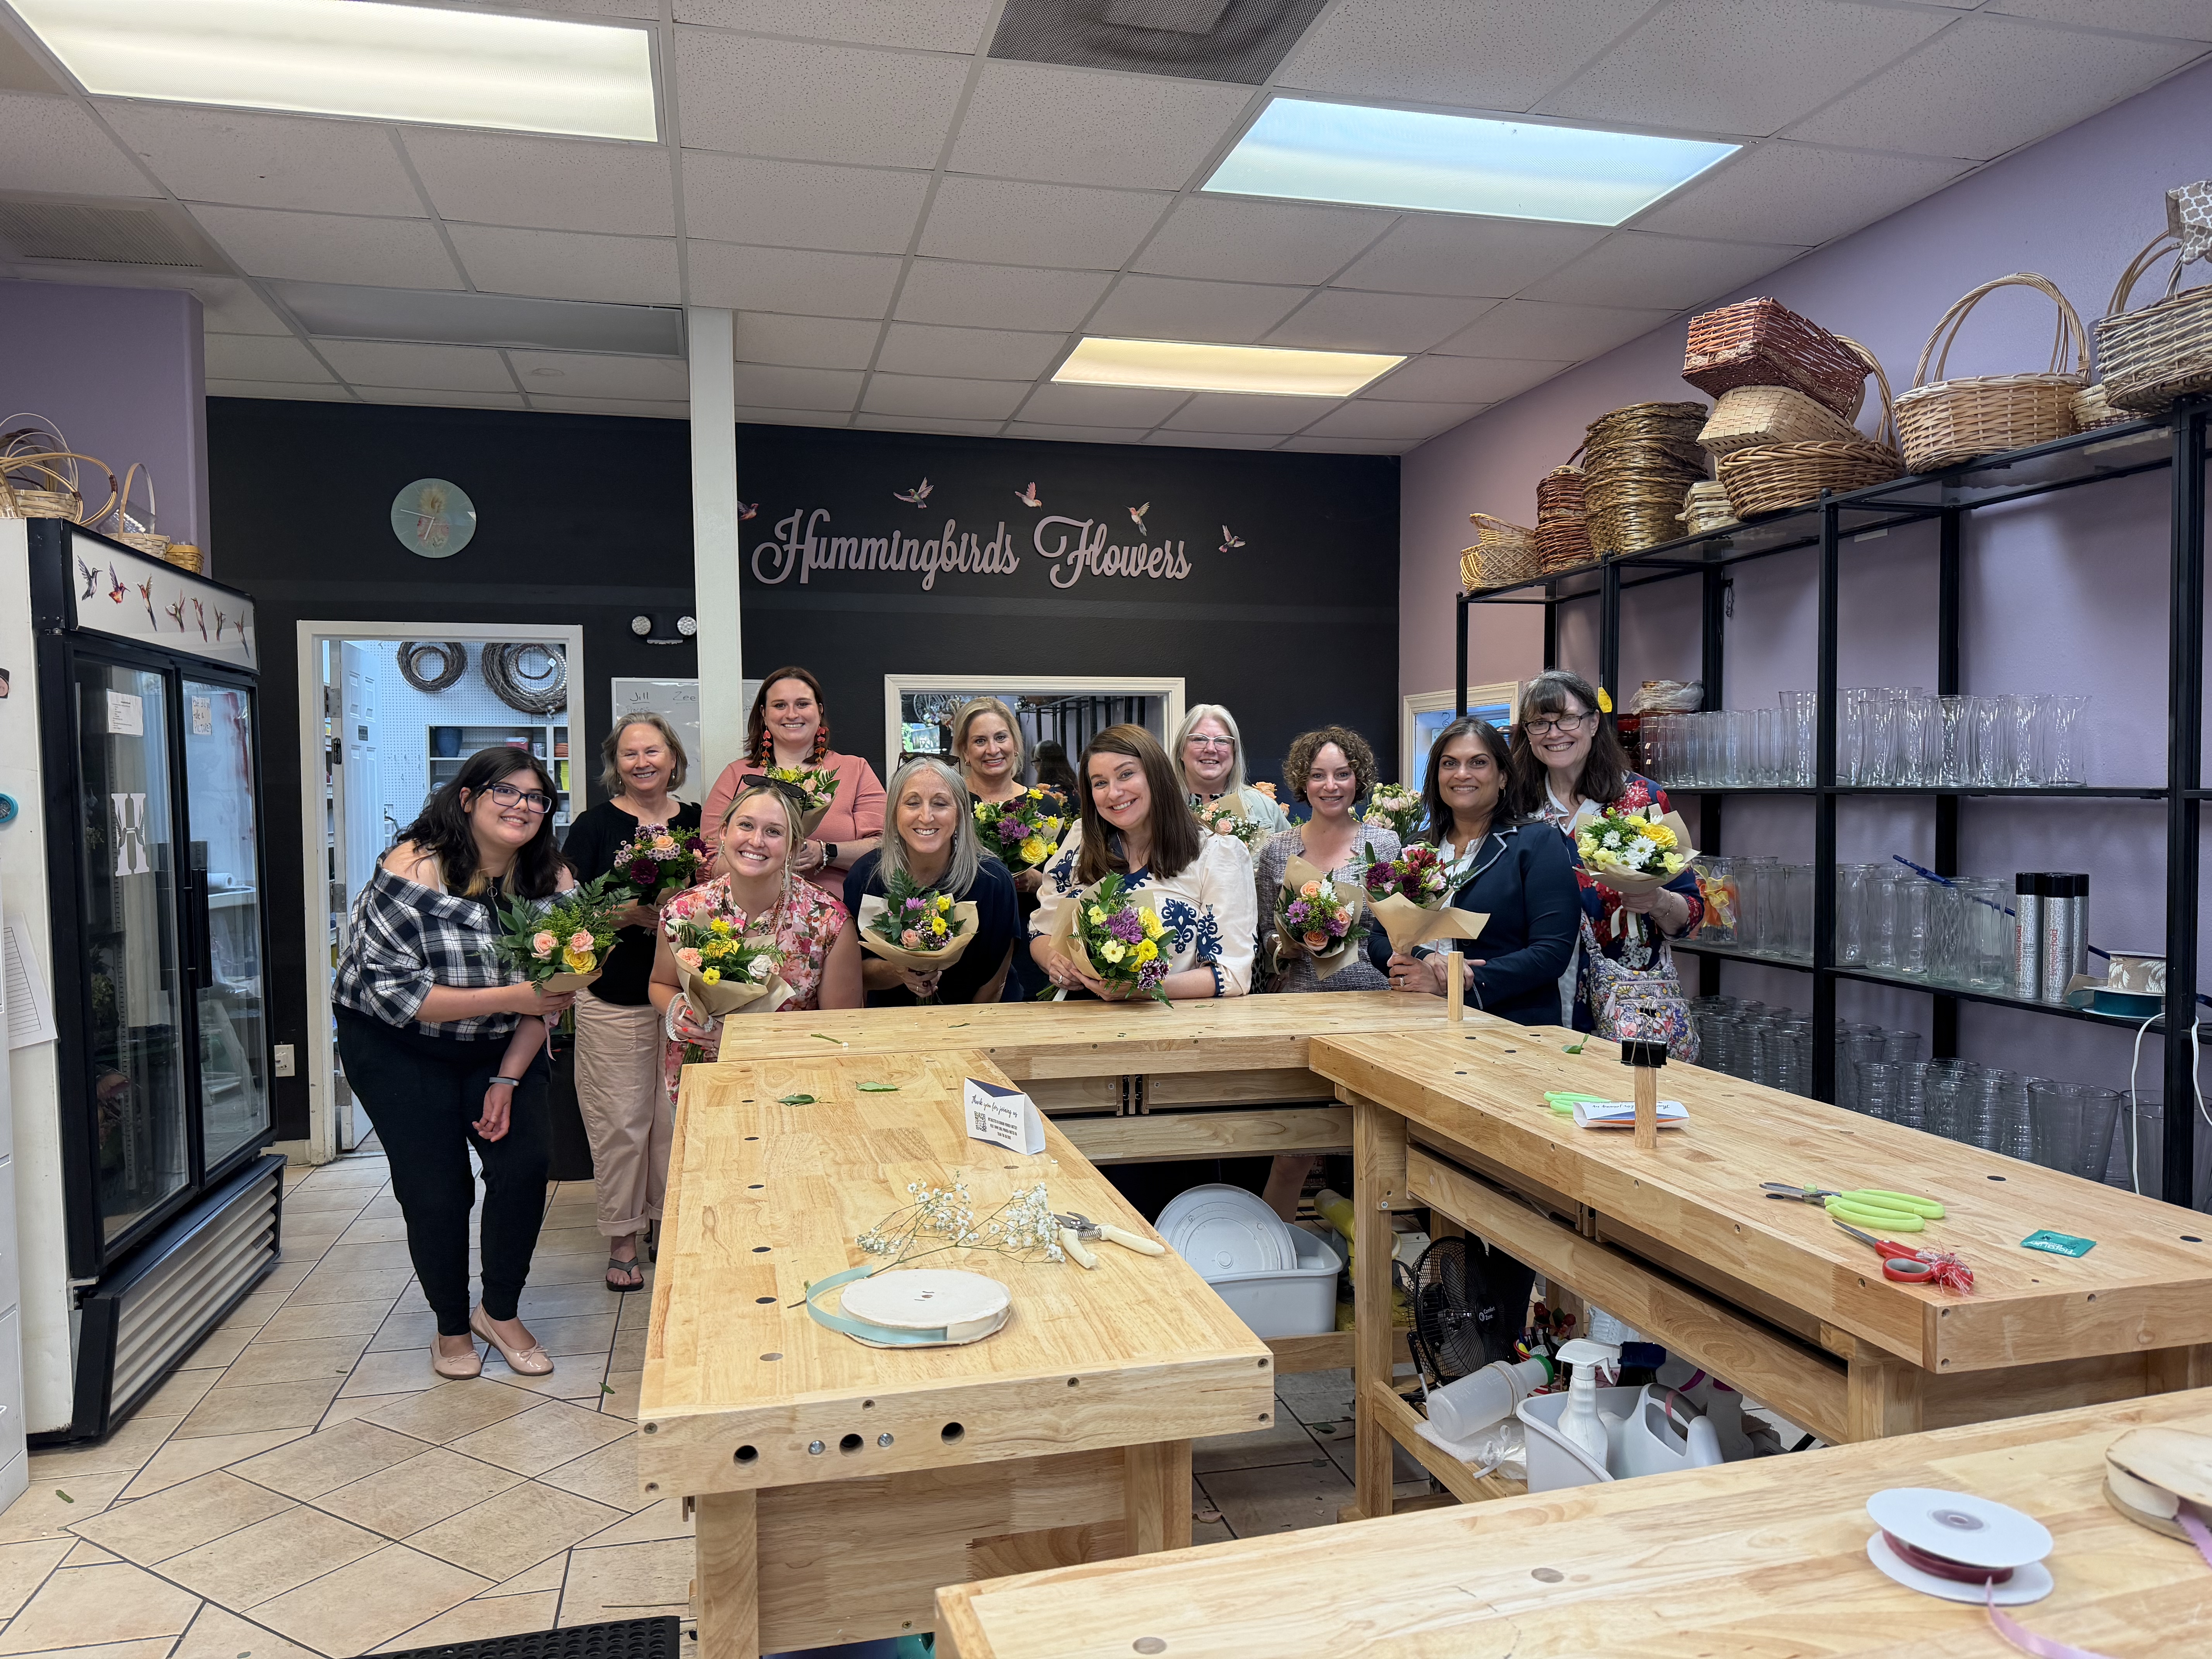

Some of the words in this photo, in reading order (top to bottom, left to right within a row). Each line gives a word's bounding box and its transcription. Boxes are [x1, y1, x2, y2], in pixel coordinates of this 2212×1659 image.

[751, 508, 1020, 591] Hummingbirds
[1034, 515, 1192, 589] Flowers
[630, 692, 649, 701] Jill
[673, 691, 696, 701] Zee
[971, 1094, 983, 1106] Thank
